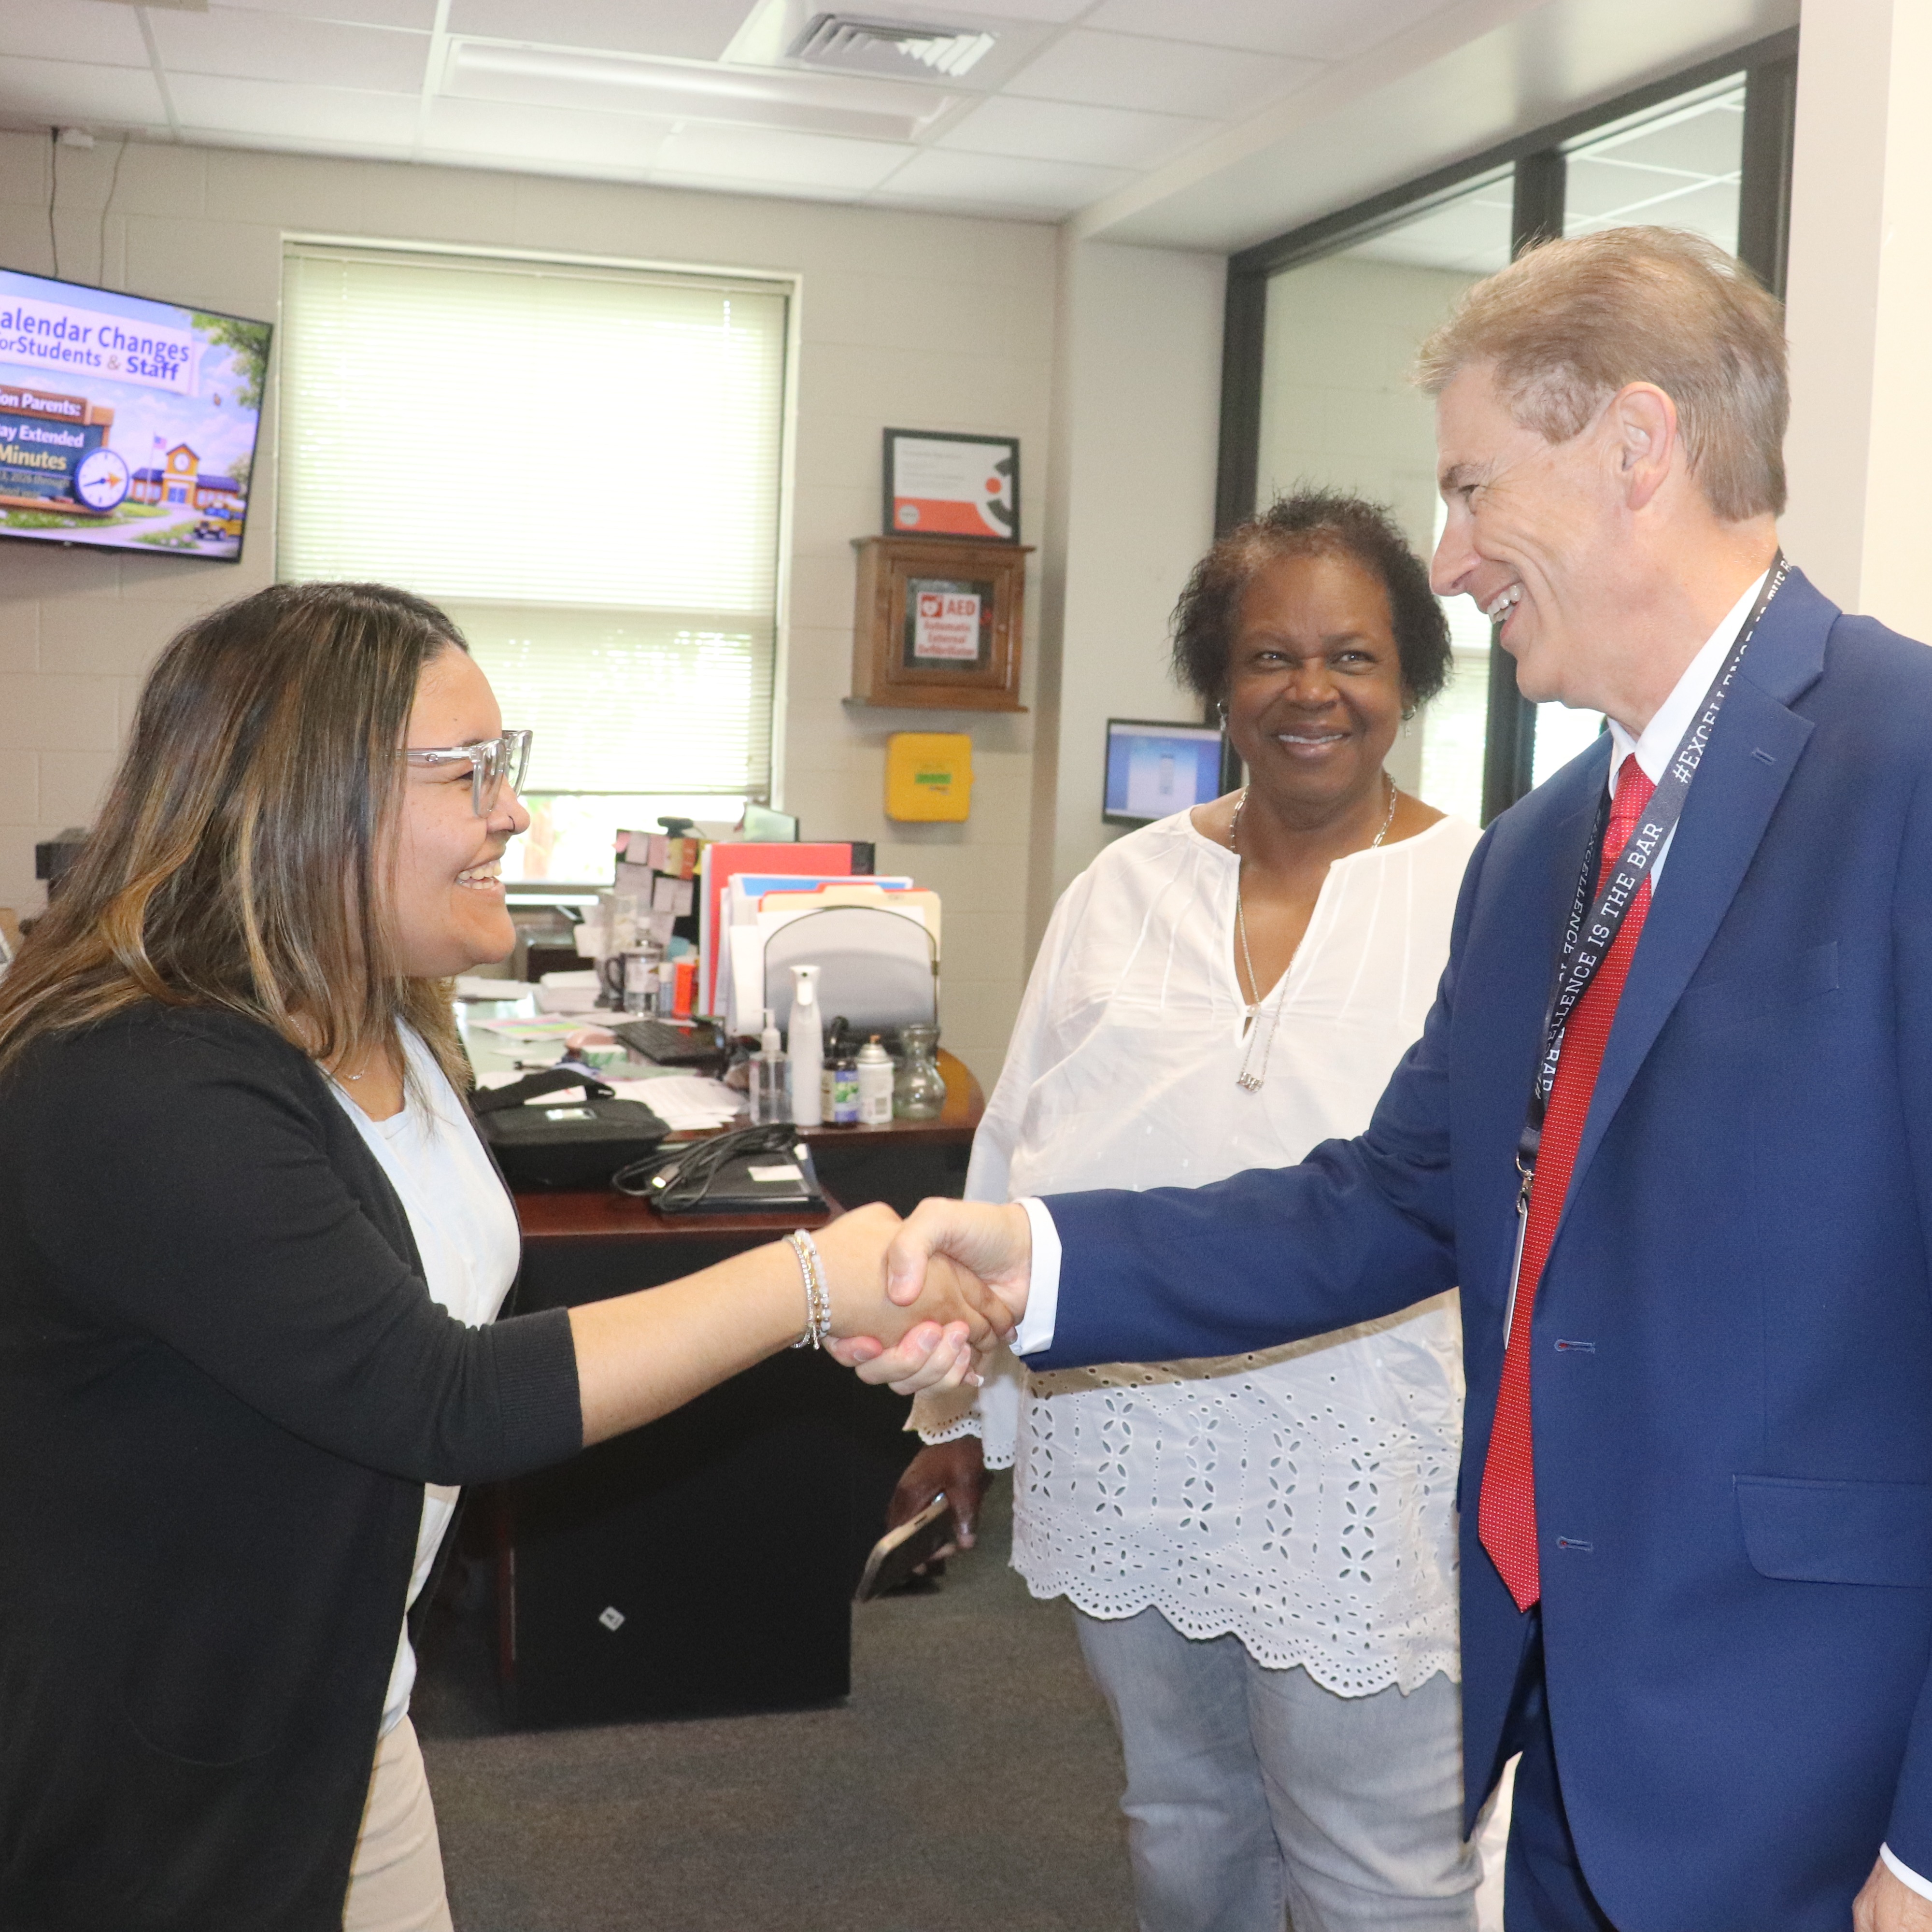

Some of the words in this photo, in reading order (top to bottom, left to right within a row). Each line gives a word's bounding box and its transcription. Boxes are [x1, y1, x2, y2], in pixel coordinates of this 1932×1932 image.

[99, 326, 189, 363] Changes
[107, 355, 120, 370] &
[126, 356, 179, 381] Staff
[0, 389, 19, 407] on
[22, 393, 81, 416] Parents:
[0, 424, 17, 442] ay
[19, 424, 85, 448] Extended
[0, 443, 67, 471] Minutes
[947, 599, 975, 616] AED
[1588, 923, 1610, 948] IS
[1600, 872, 1636, 918] THE
[1627, 823, 1663, 869] BAR
